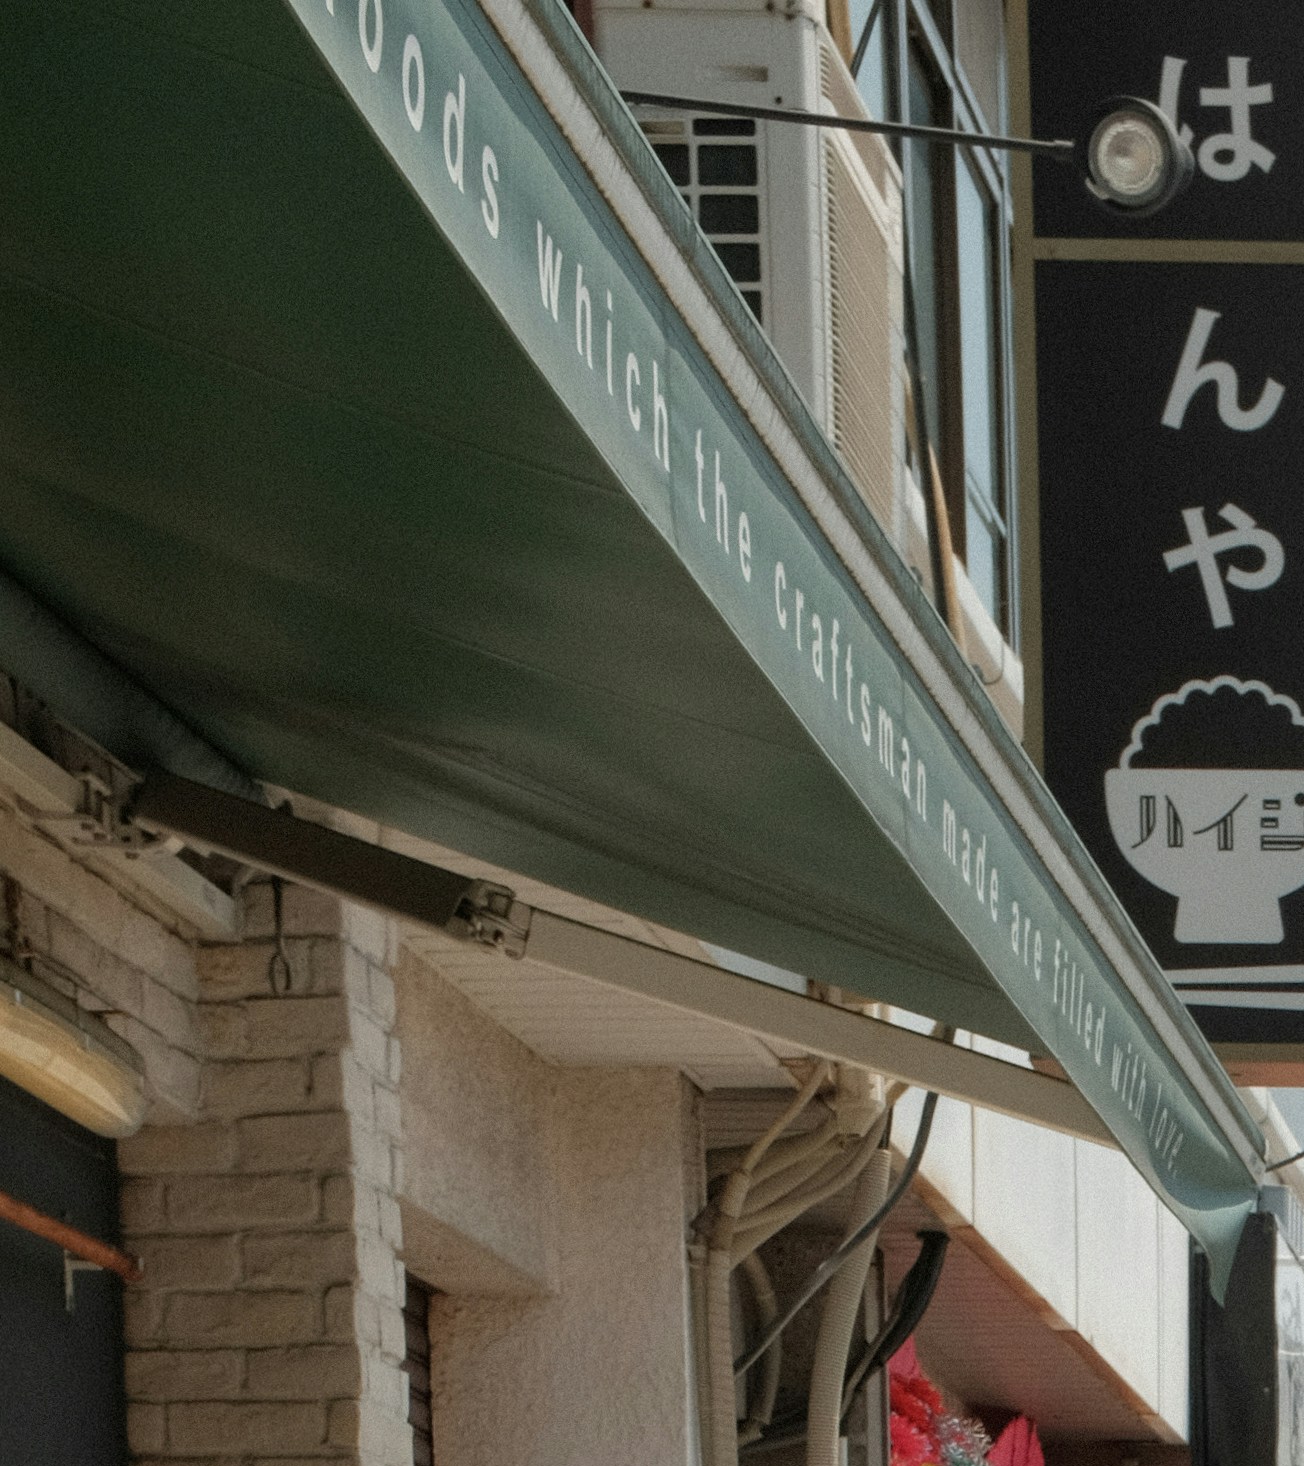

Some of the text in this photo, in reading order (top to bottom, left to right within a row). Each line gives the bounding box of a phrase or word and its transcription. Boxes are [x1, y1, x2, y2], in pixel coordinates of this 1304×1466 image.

[325, 0, 499, 240] oods
[537, 220, 671, 472] which
[695, 429, 751, 583] the
[775, 561, 926, 822] craftsman
[943, 800, 998, 922] made
[1012, 901, 1042, 982] are
[1054, 939, 1105, 1067] filled
[1111, 1042, 1146, 1121] with
